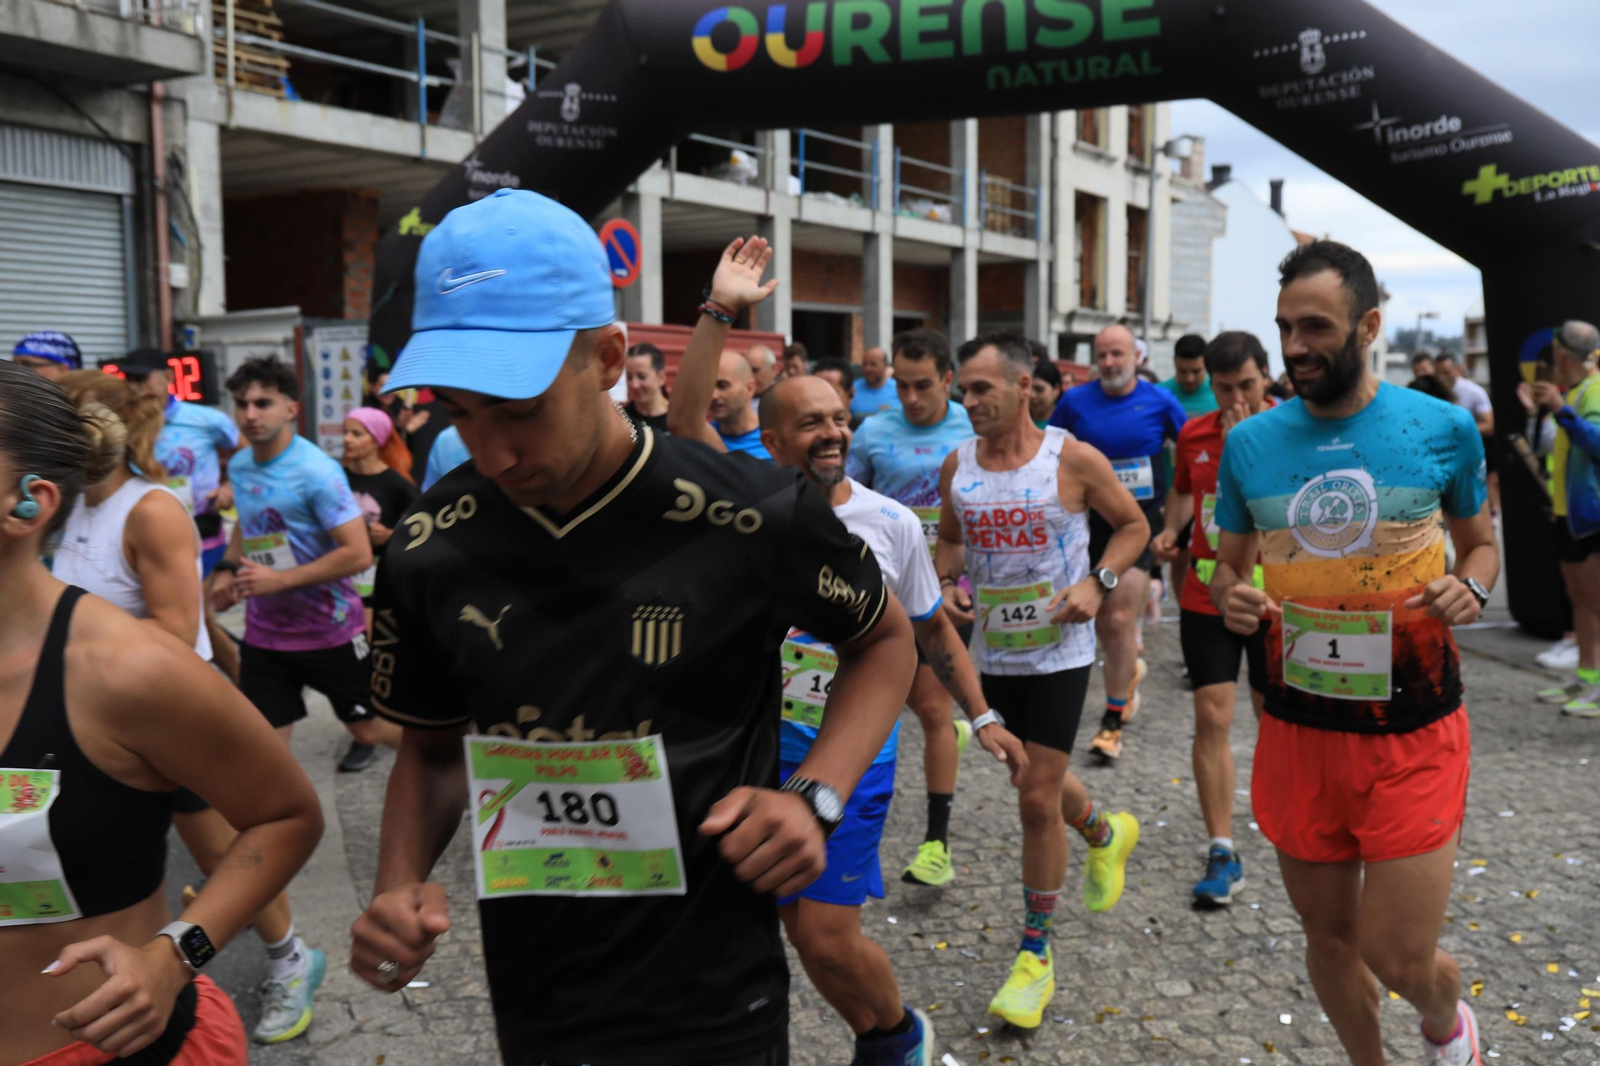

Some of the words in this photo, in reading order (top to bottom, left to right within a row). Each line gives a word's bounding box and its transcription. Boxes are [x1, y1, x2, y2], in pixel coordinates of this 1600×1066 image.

[987, 50, 1163, 90] NATURAL
[963, 508, 1027, 528] CABO
[1029, 510, 1044, 521] DE
[967, 526, 1048, 549] PEÑAS
[1001, 605, 1038, 622] 142
[1328, 639, 1341, 659] 1
[536, 790, 619, 827] 180
